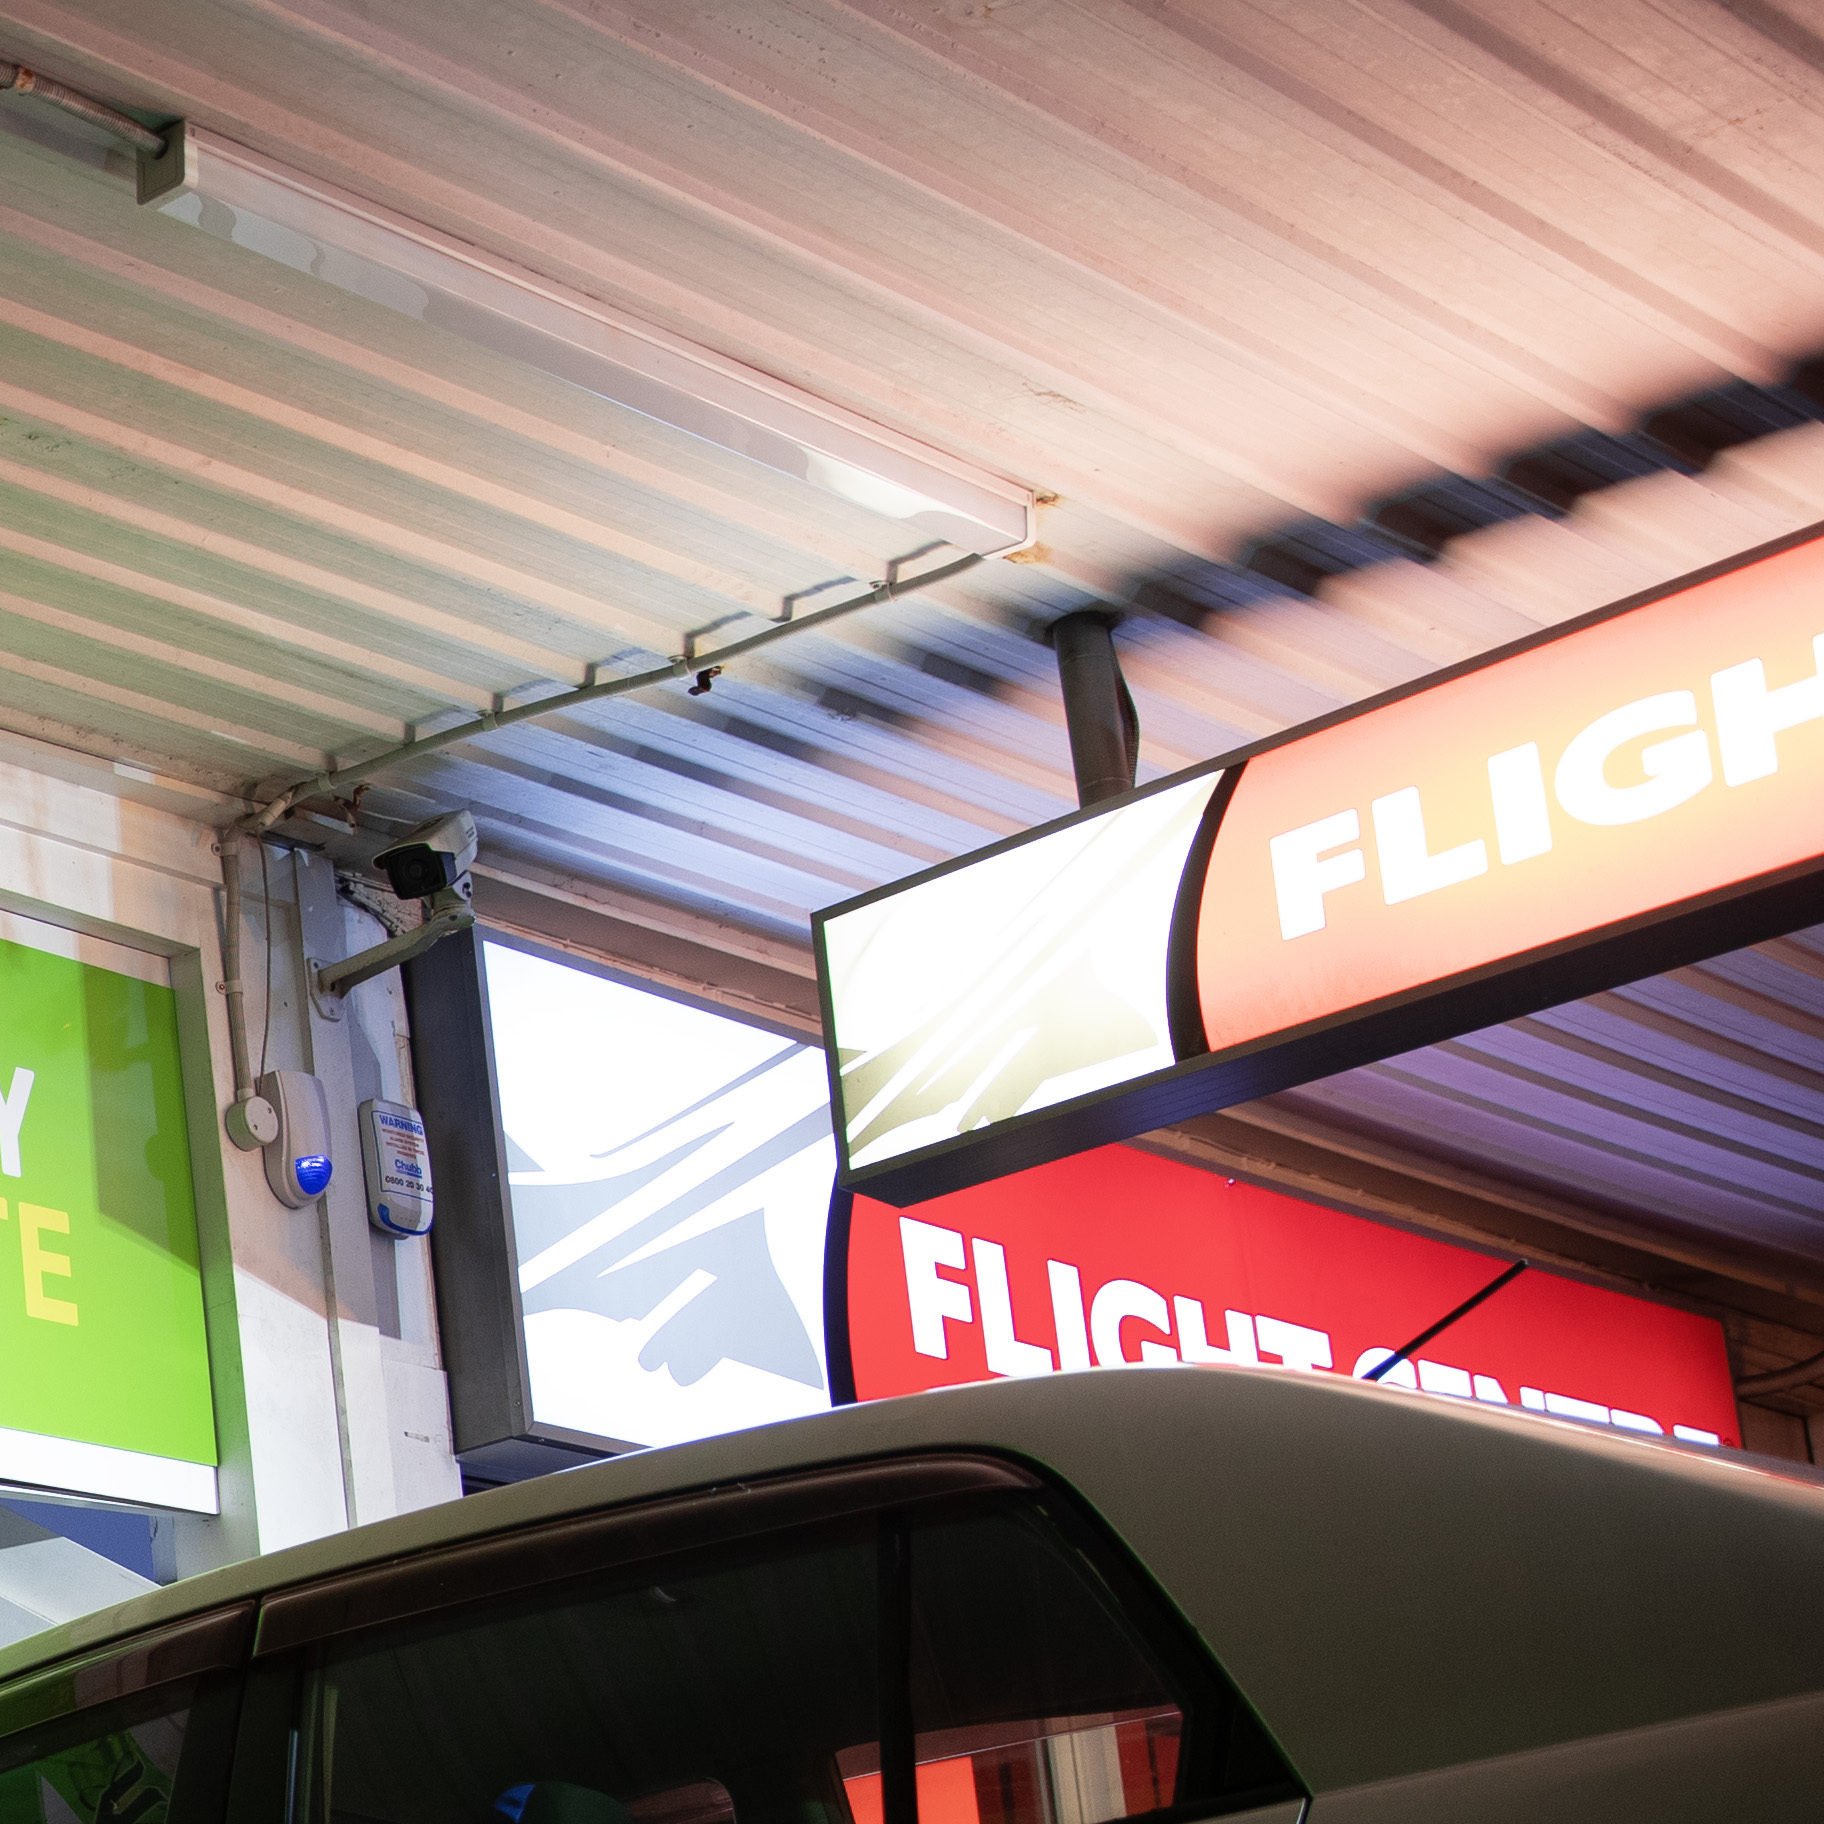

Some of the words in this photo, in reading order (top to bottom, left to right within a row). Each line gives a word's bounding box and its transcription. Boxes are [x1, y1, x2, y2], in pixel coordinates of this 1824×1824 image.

[1269, 632, 1824, 941] FLIGH
[379, 1114, 423, 1135] WARNING
[395, 1159, 422, 1174] Chubb
